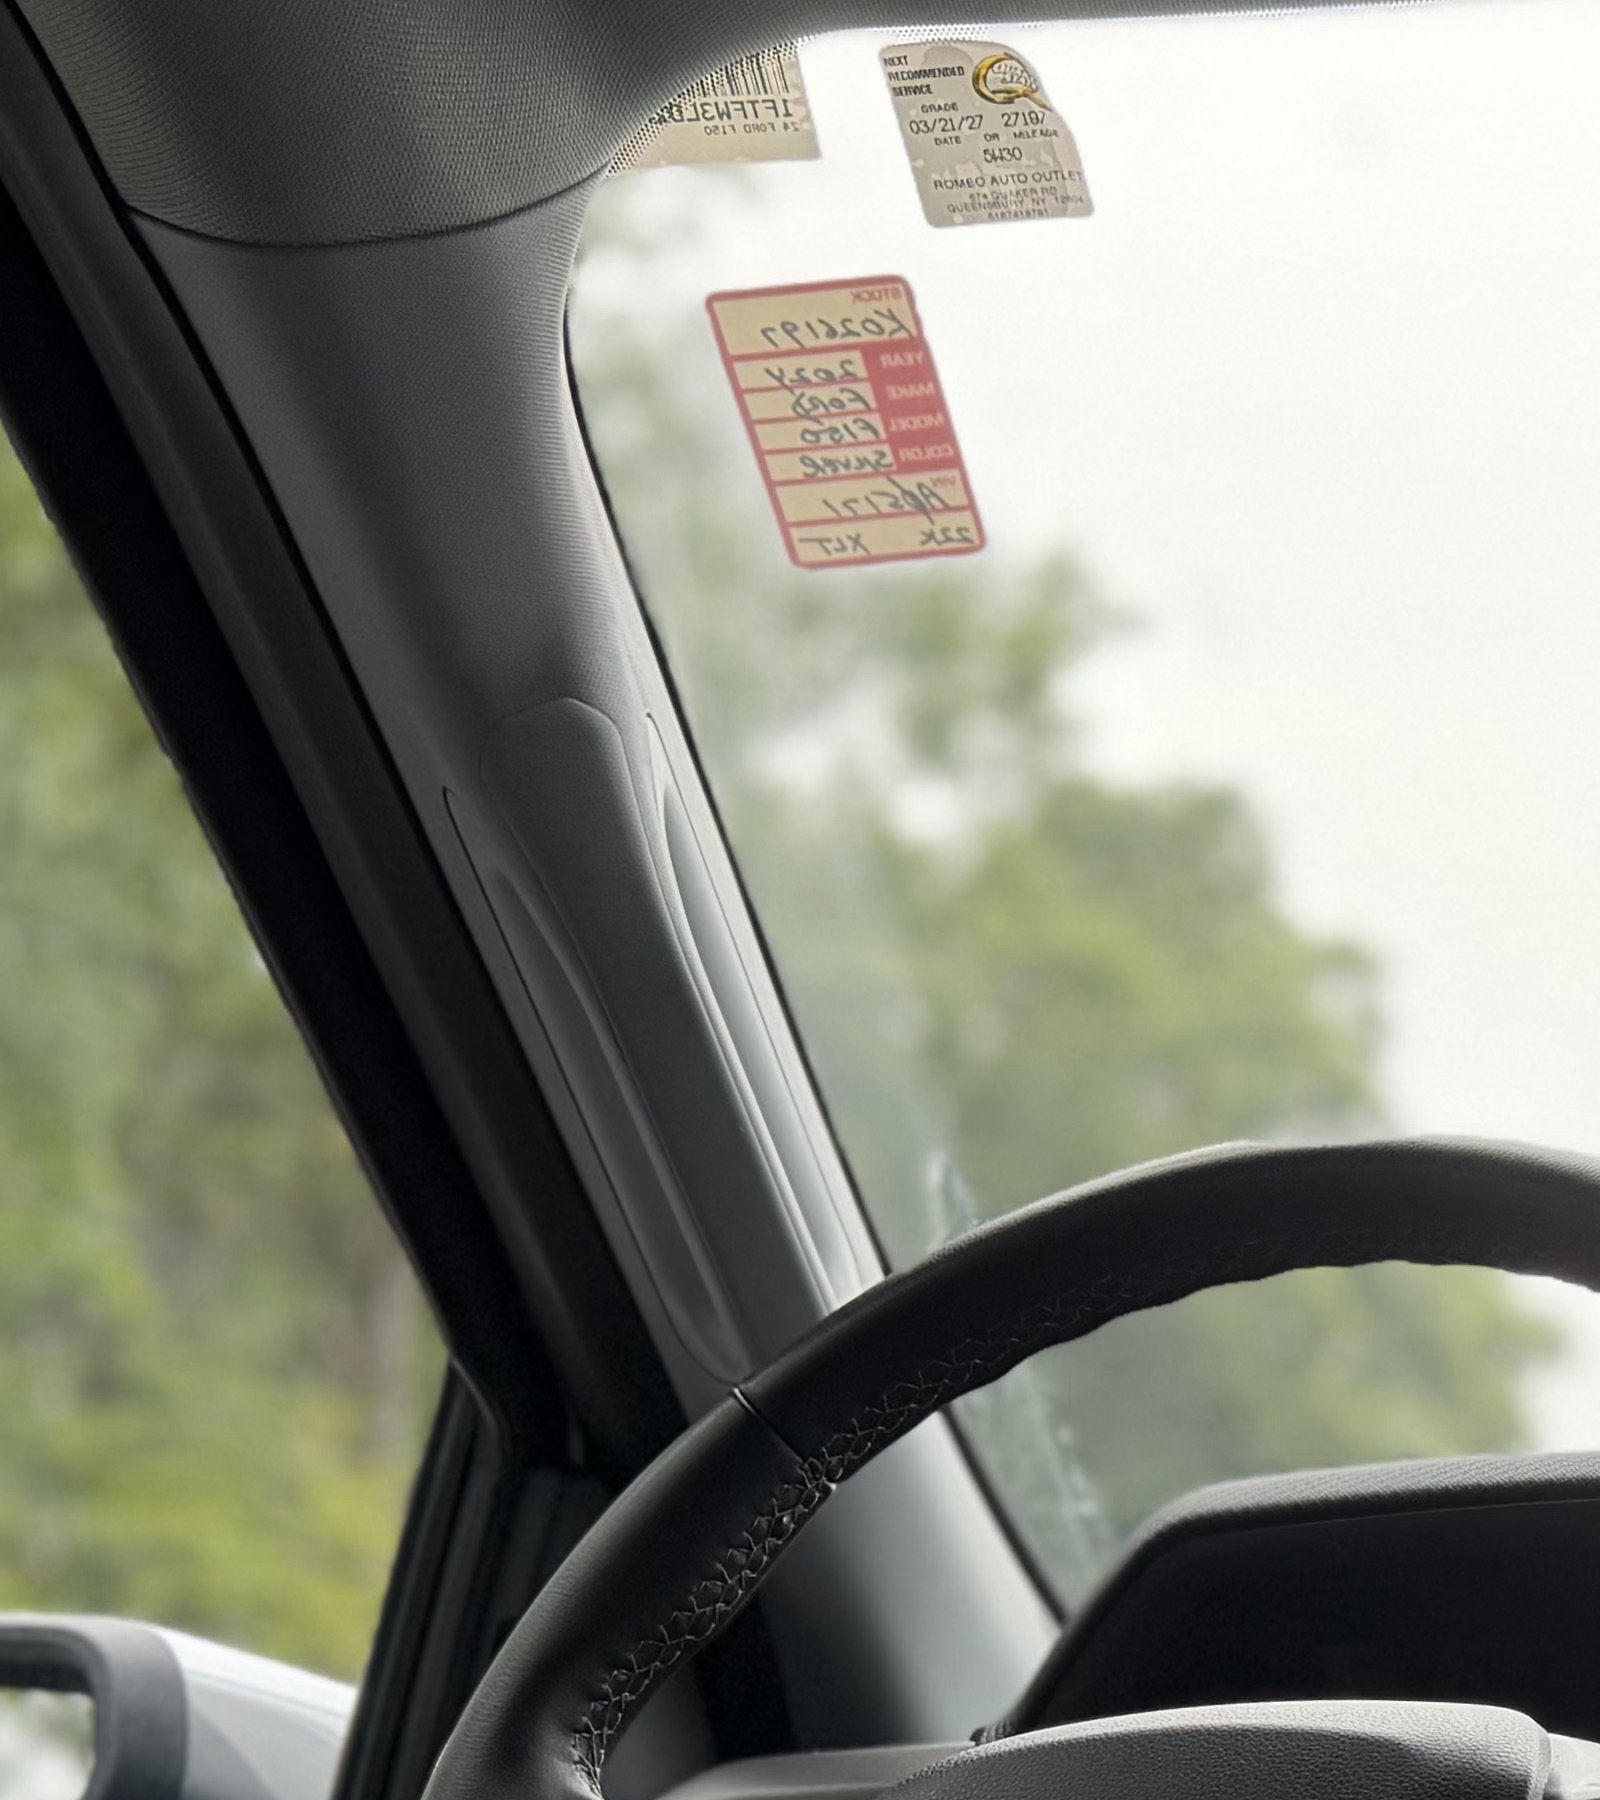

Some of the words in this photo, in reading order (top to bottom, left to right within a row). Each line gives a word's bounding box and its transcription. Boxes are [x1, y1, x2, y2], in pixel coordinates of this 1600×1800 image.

[883, 56, 908, 66] NEXT
[888, 66, 965, 81] RECOMMENDED
[892, 84, 933, 97] SERVICE
[921, 102, 958, 113] GRADE
[909, 115, 983, 134] 03/21/27
[935, 136, 962, 146] DATE
[984, 133, 999, 142] OR
[983, 147, 1022, 163] 5W30
[933, 176, 985, 190] ROMEO
[990, 172, 1028, 185] AUTO
[1032, 170, 1083, 182] OUTLET
